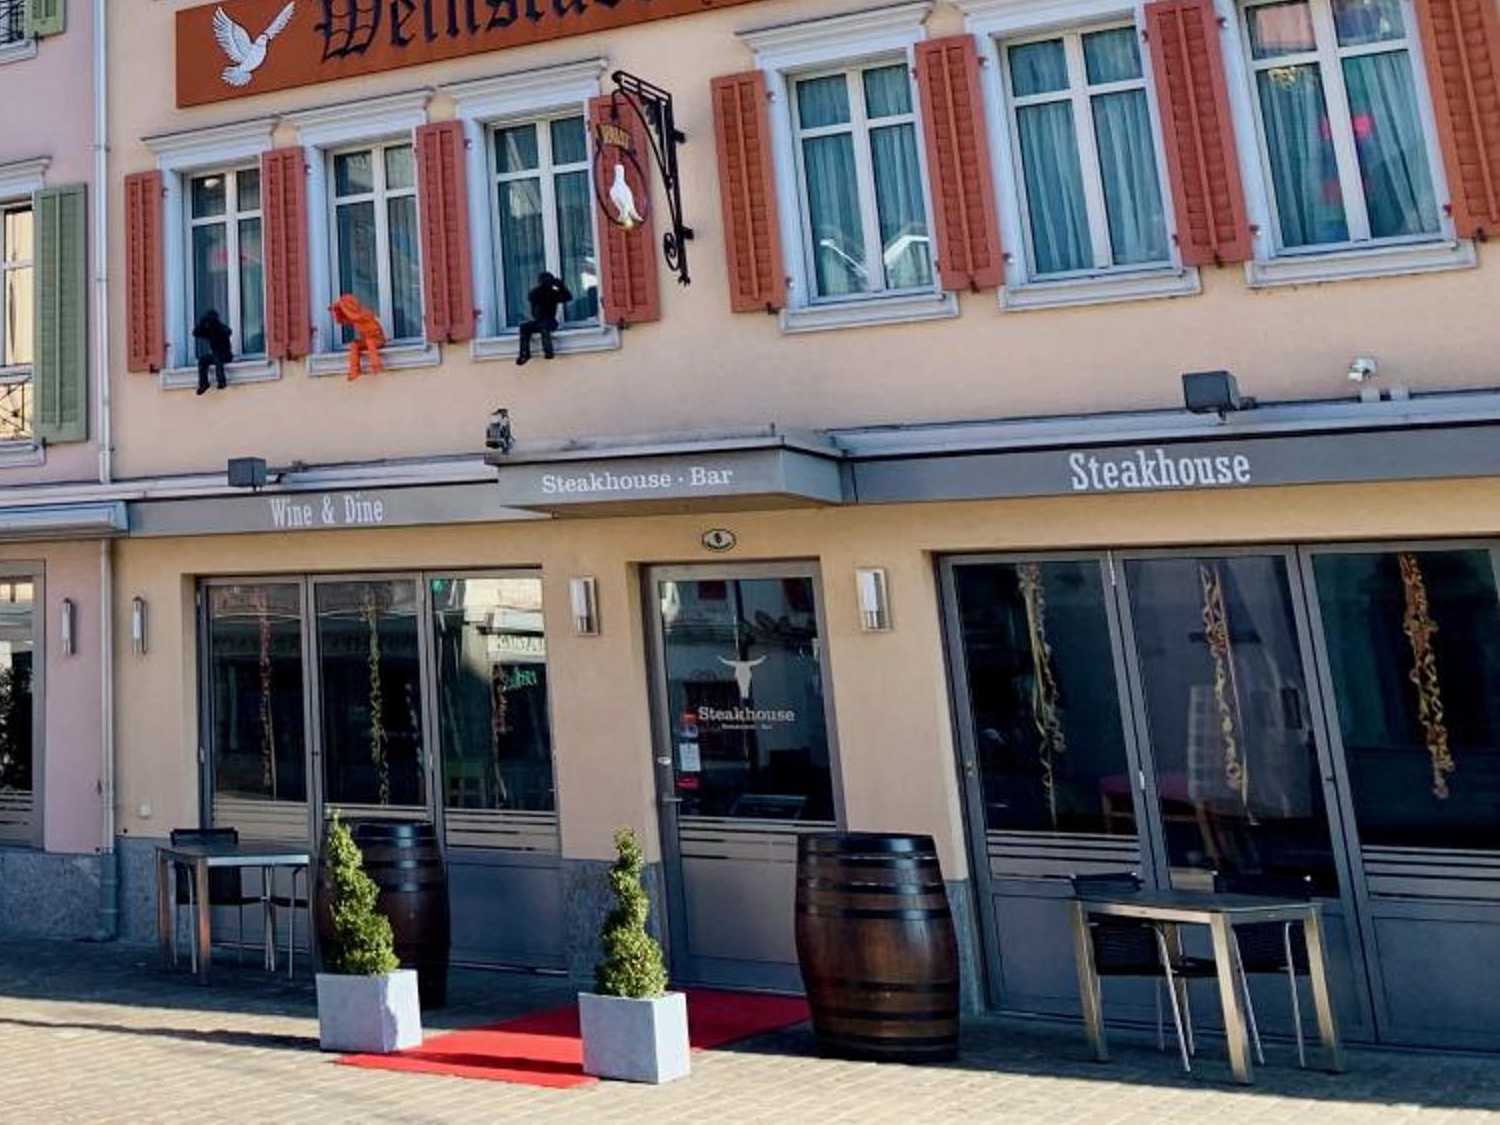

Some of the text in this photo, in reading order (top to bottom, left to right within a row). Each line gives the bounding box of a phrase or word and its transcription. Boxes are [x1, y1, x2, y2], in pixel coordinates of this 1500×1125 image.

[541, 468, 672, 495] Steakhouse
[690, 465, 734, 489] Bar
[1069, 448, 1252, 492] Steakhouse
[270, 492, 385, 528] Wine & Dine
[698, 706, 796, 723] Steakhouse
